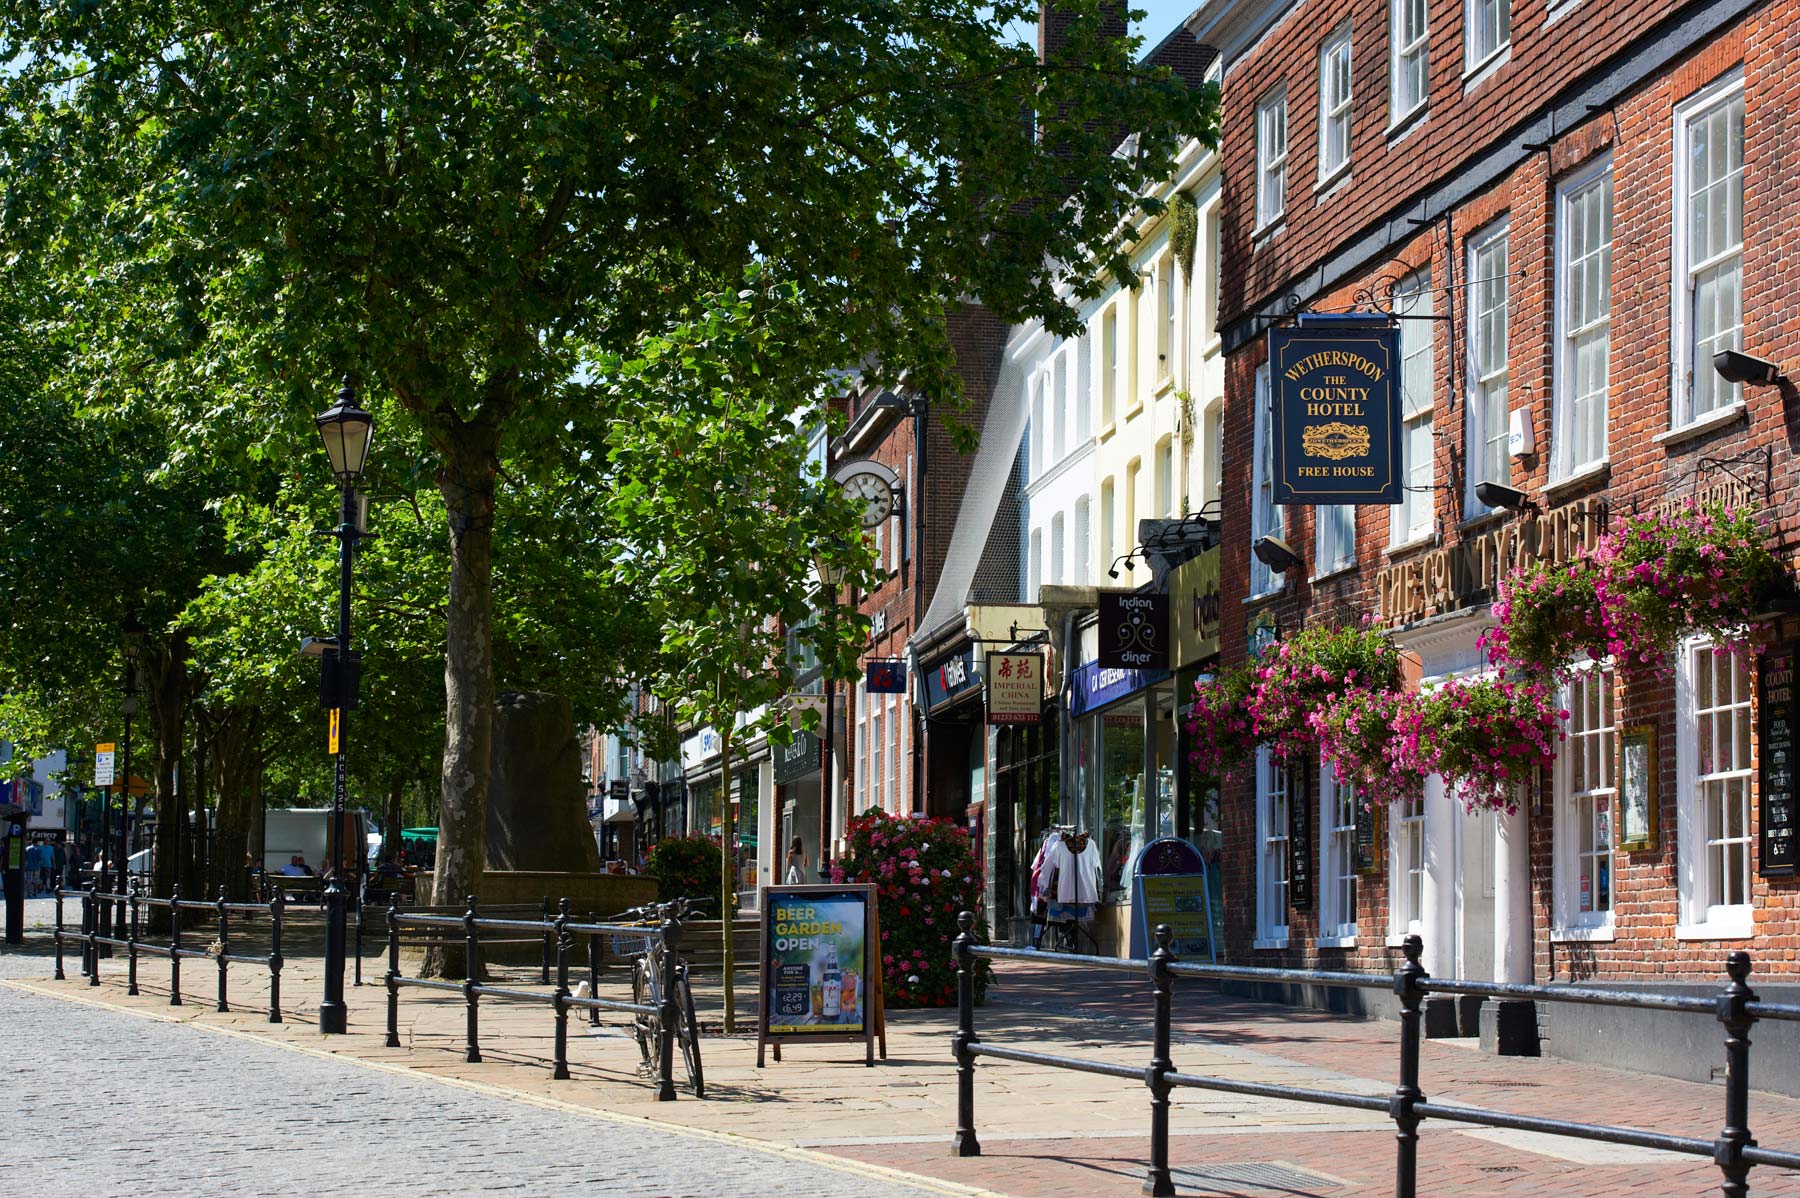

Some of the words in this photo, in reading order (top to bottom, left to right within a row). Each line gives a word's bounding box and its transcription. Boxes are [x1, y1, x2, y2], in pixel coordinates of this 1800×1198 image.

[1284, 351, 1386, 383] WETHERSPOON
[1323, 375, 1346, 385] THE
[1299, 387, 1370, 401] COUNTY
[1306, 403, 1365, 416] HOTEL
[1298, 466, 1330, 477] FREE
[1333, 466, 1375, 477] HOUSE
[1376, 562, 1416, 620] THE
[1423, 528, 1512, 607] COUNTY
[1517, 497, 1600, 569] HOTEL
[1119, 596, 1154, 611] Indian
[1121, 650, 1151, 665] diner
[1765, 669, 1793, 687] COUNTY
[994, 682, 1037, 690] IMPERIAL
[1001, 691, 1029, 699] CHINA
[1768, 687, 1791, 704] HOTEL
[776, 908, 815, 921] BEER
[775, 921, 842, 936] GARDEN
[775, 937, 819, 951] OPEN
